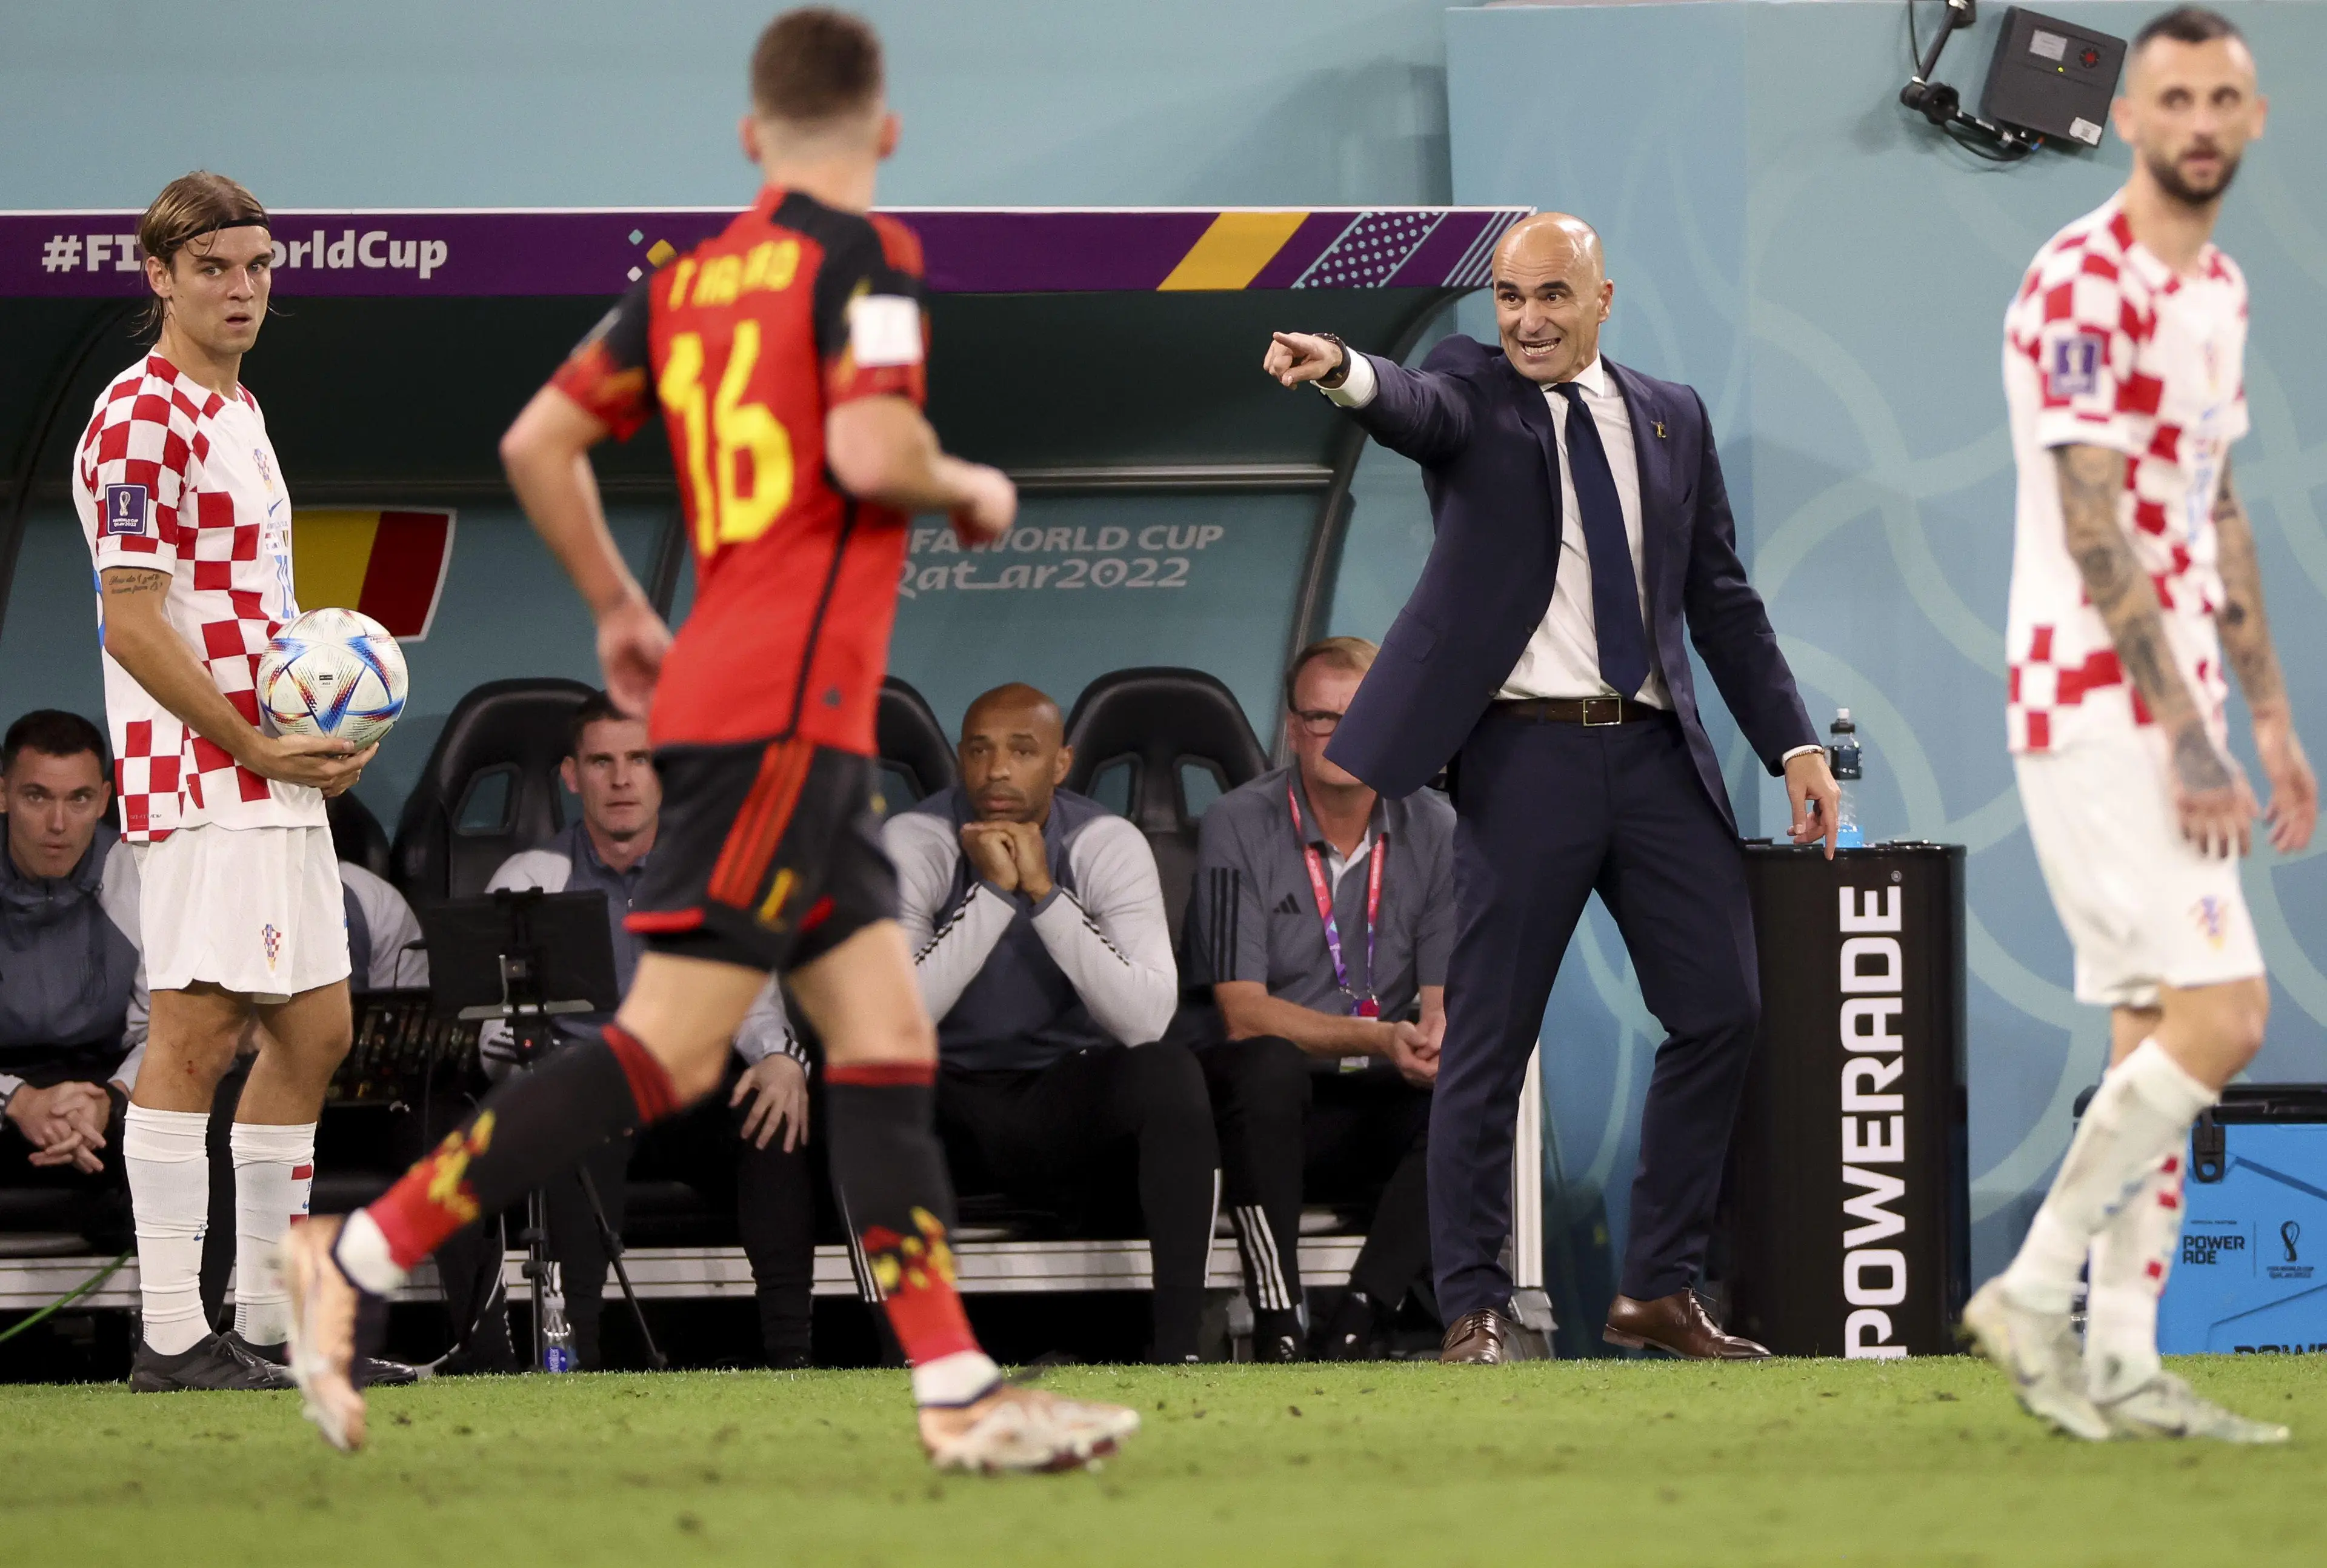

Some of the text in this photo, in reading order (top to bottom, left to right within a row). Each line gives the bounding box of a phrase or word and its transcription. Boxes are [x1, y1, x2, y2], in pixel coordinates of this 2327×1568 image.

[42, 230, 448, 279] #FIorldCup
[658, 319, 794, 557] 16
[910, 527, 960, 555] FA
[1137, 525, 1225, 551] CUP
[1839, 885, 1908, 1359] POWERADE
[2183, 1235, 2245, 1250] POWER
[2183, 1251, 2217, 1265] ADE
